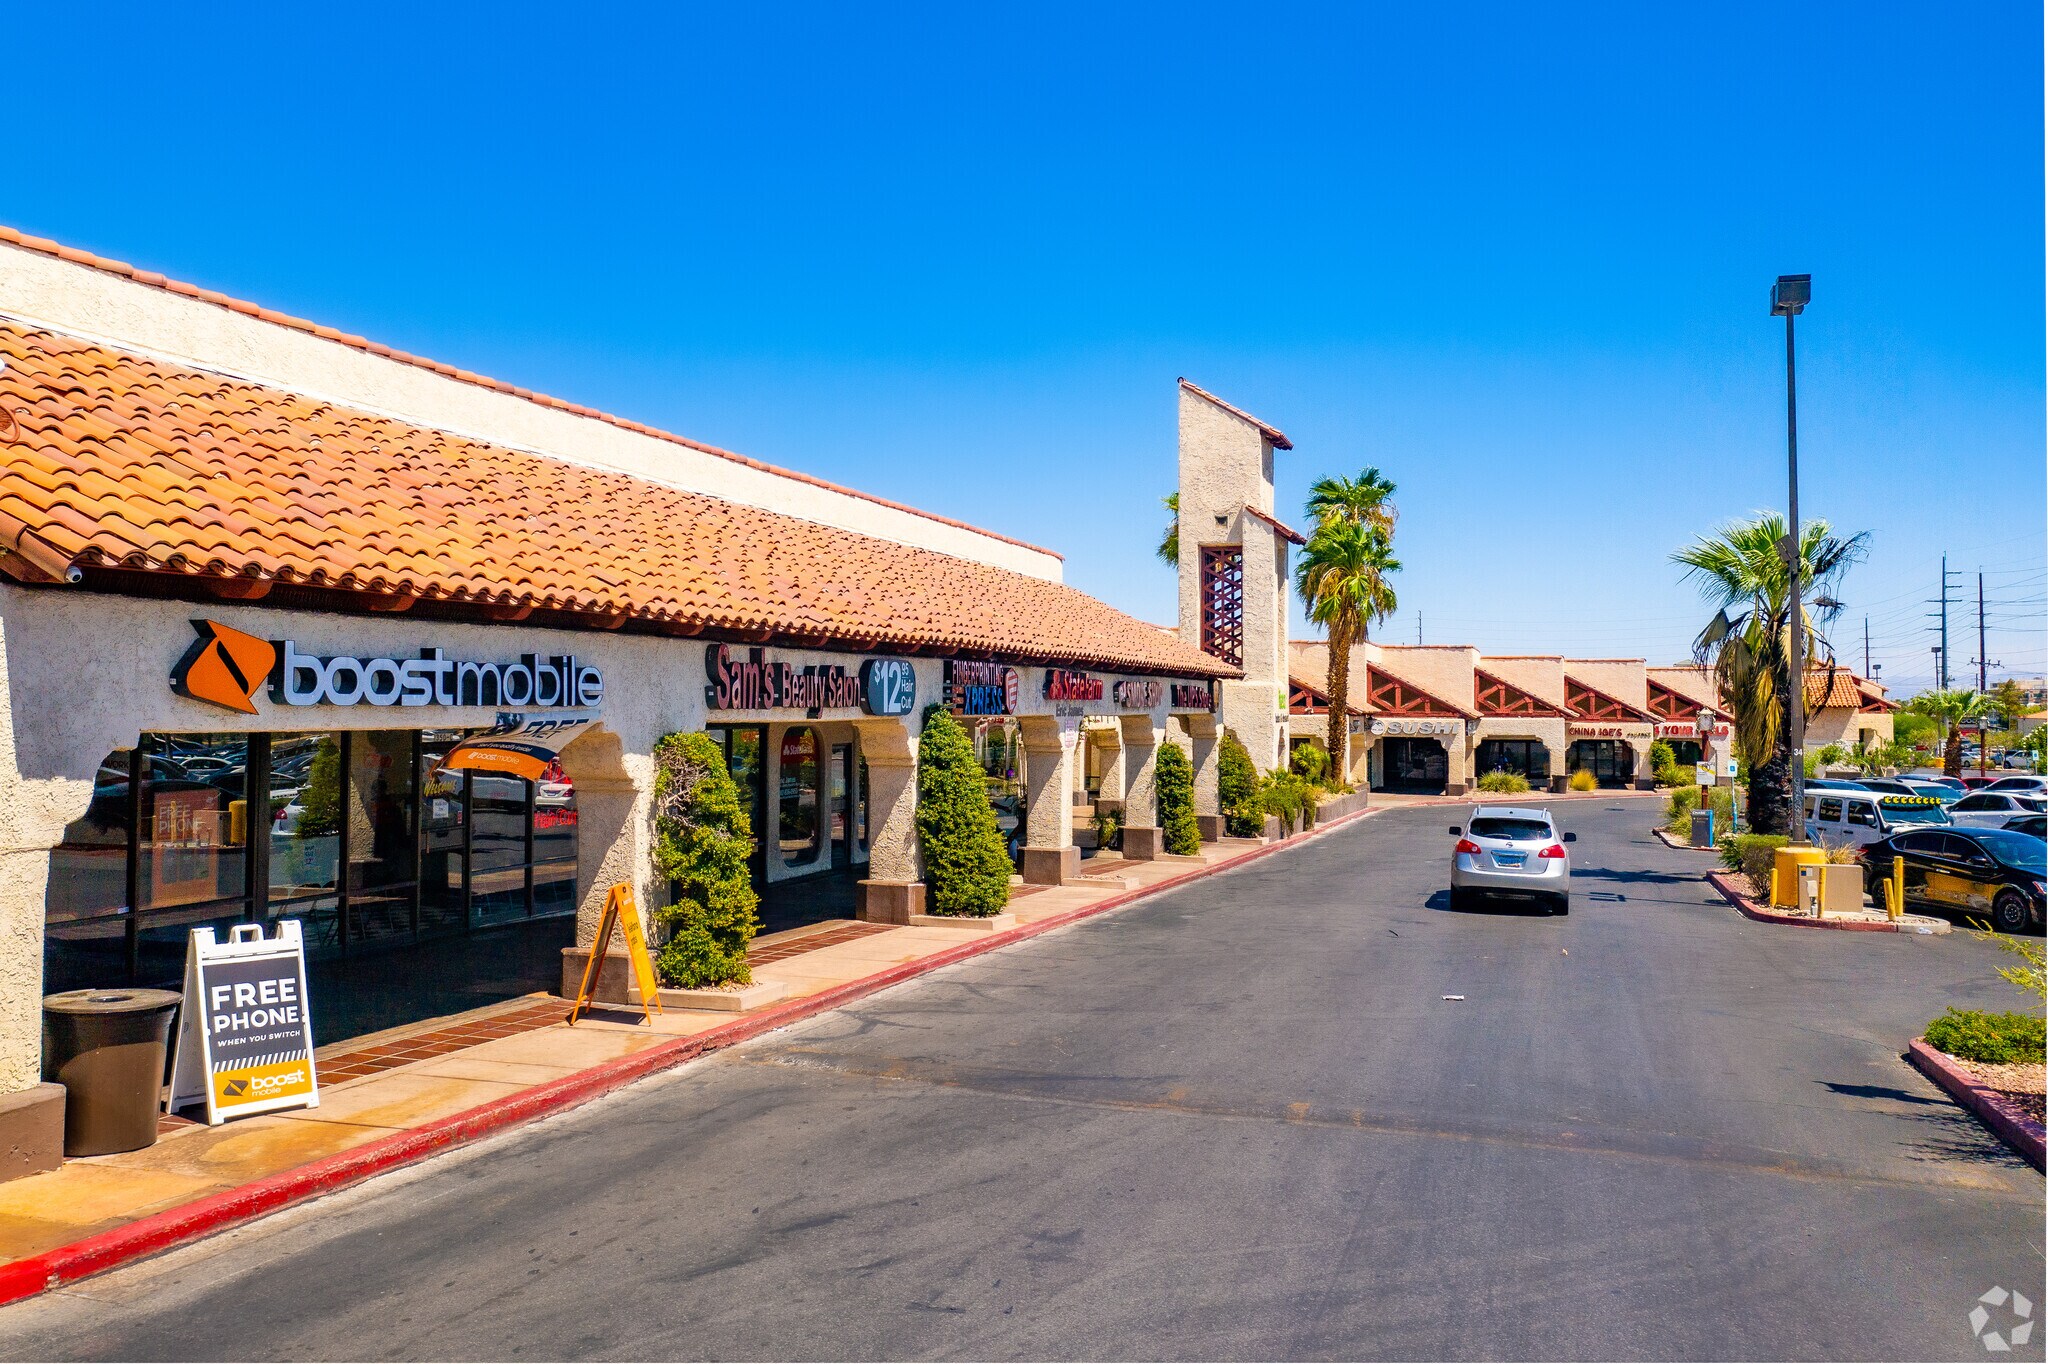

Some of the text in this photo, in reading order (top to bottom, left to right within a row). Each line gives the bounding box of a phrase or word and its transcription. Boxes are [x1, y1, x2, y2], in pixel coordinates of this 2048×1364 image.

[717, 642, 861, 719] Sam's Beauty Salon
[953, 660, 1003, 686] FINGERPRINTING
[874, 660, 901, 713] $12
[901, 680, 914, 693] Hair
[901, 696, 912, 709] Cut
[1387, 721, 1460, 735] SUSHI
[1569, 727, 1623, 737] CHINA JOE'S
[1664, 725, 1693, 735] YOUR
[1793, 748, 1803, 756] 34
[211, 977, 298, 1011] FREE
[213, 1006, 299, 1034] PHONE
[217, 1029, 301, 1048] WHEN YOU SWITCH
[251, 1069, 305, 1090] boost
[251, 1086, 282, 1097] mobile
